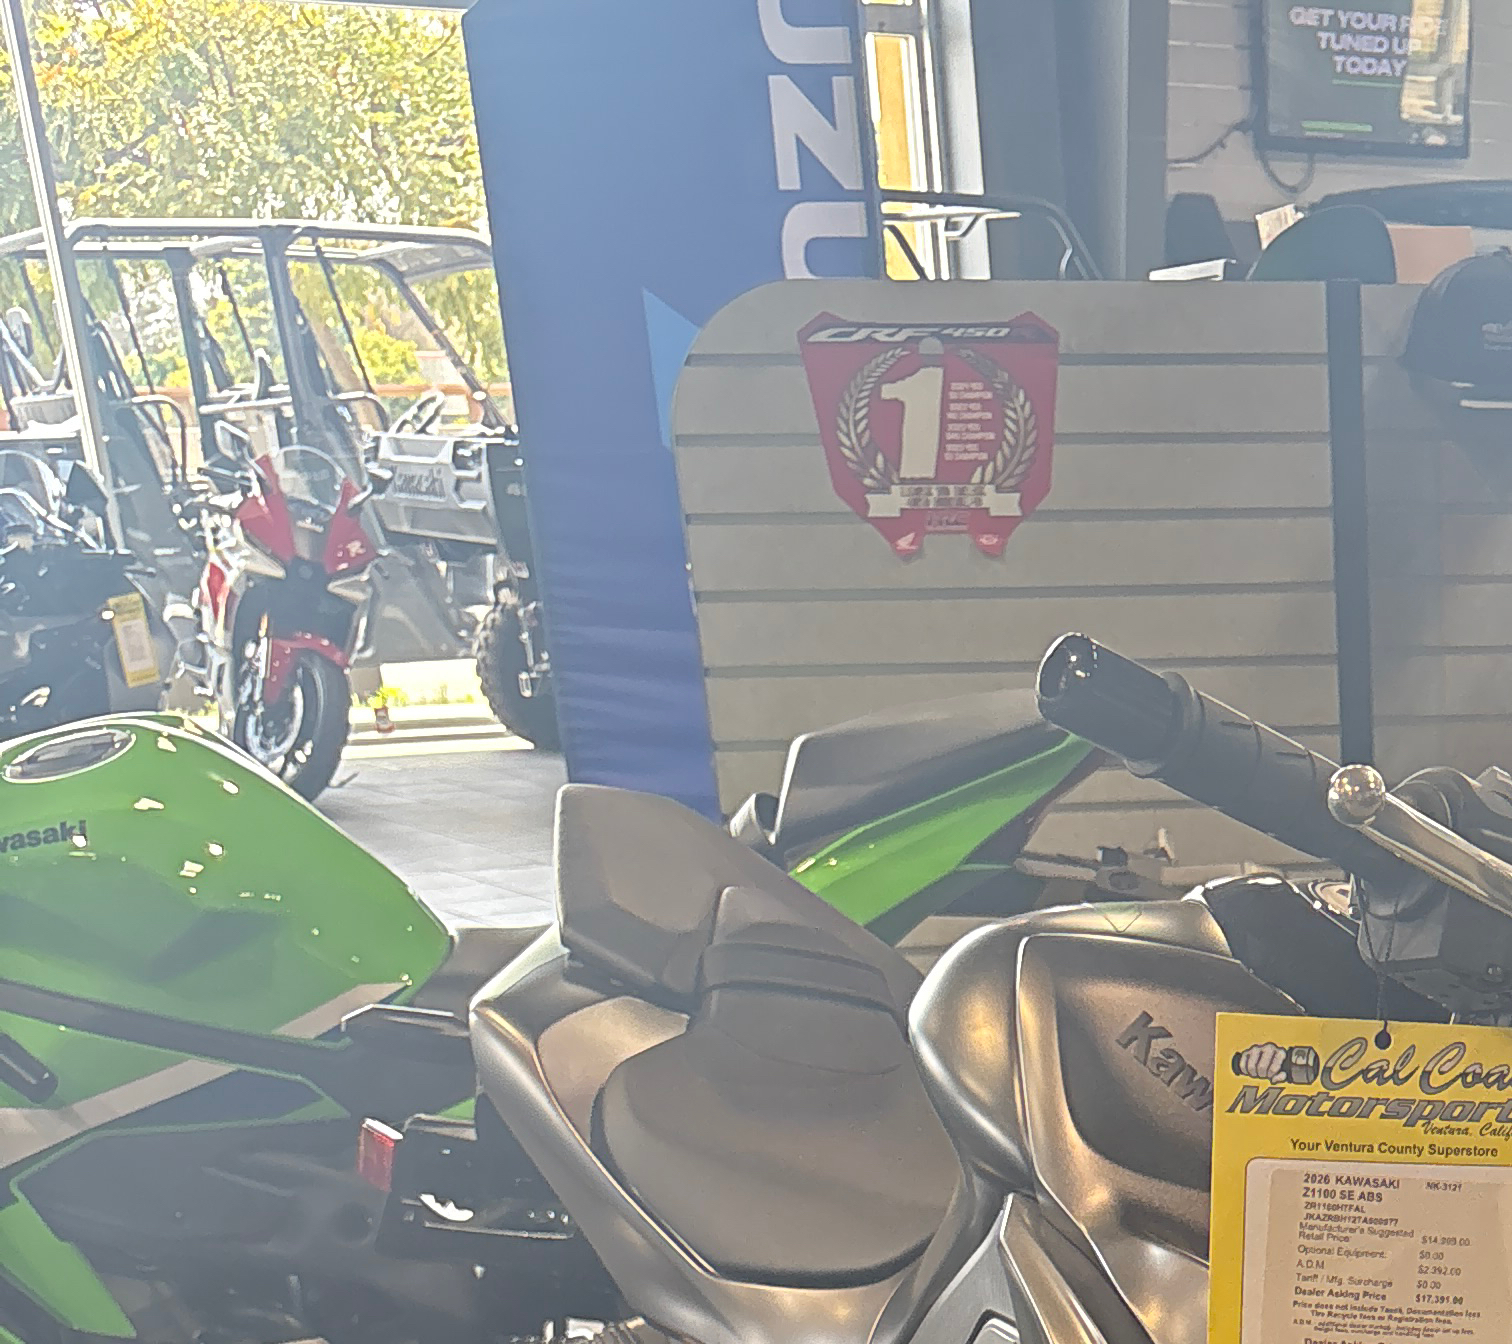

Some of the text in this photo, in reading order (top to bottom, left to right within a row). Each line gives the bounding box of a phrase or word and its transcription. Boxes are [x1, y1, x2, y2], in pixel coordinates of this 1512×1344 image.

[1289, 6, 1335, 27] GET
[1338, 9, 1398, 32] YOUR
[1316, 31, 1390, 54] TUNED
[1332, 55, 1407, 76] TODAY
[881, 366, 944, 480] 1
[1321, 1036, 1417, 1090] Cal
[1291, 1139, 1498, 1158] Your Ventura County Superstore
[1303, 1173, 1330, 1185] 2026
[1335, 1176, 1400, 1189] KAWASAKI
[1302, 1187, 1383, 1202] Z1100 SE ABS
[1299, 1231, 1324, 1241] Retail
[1367, 1227, 1414, 1238] Suggested
[1298, 1245, 1334, 1256] Optional
[1348, 1276, 1393, 1288] Surcharge
[1294, 1286, 1325, 1297] Dealer
[1327, 1288, 1360, 1300] Asking
[1362, 1291, 1387, 1301] Price
